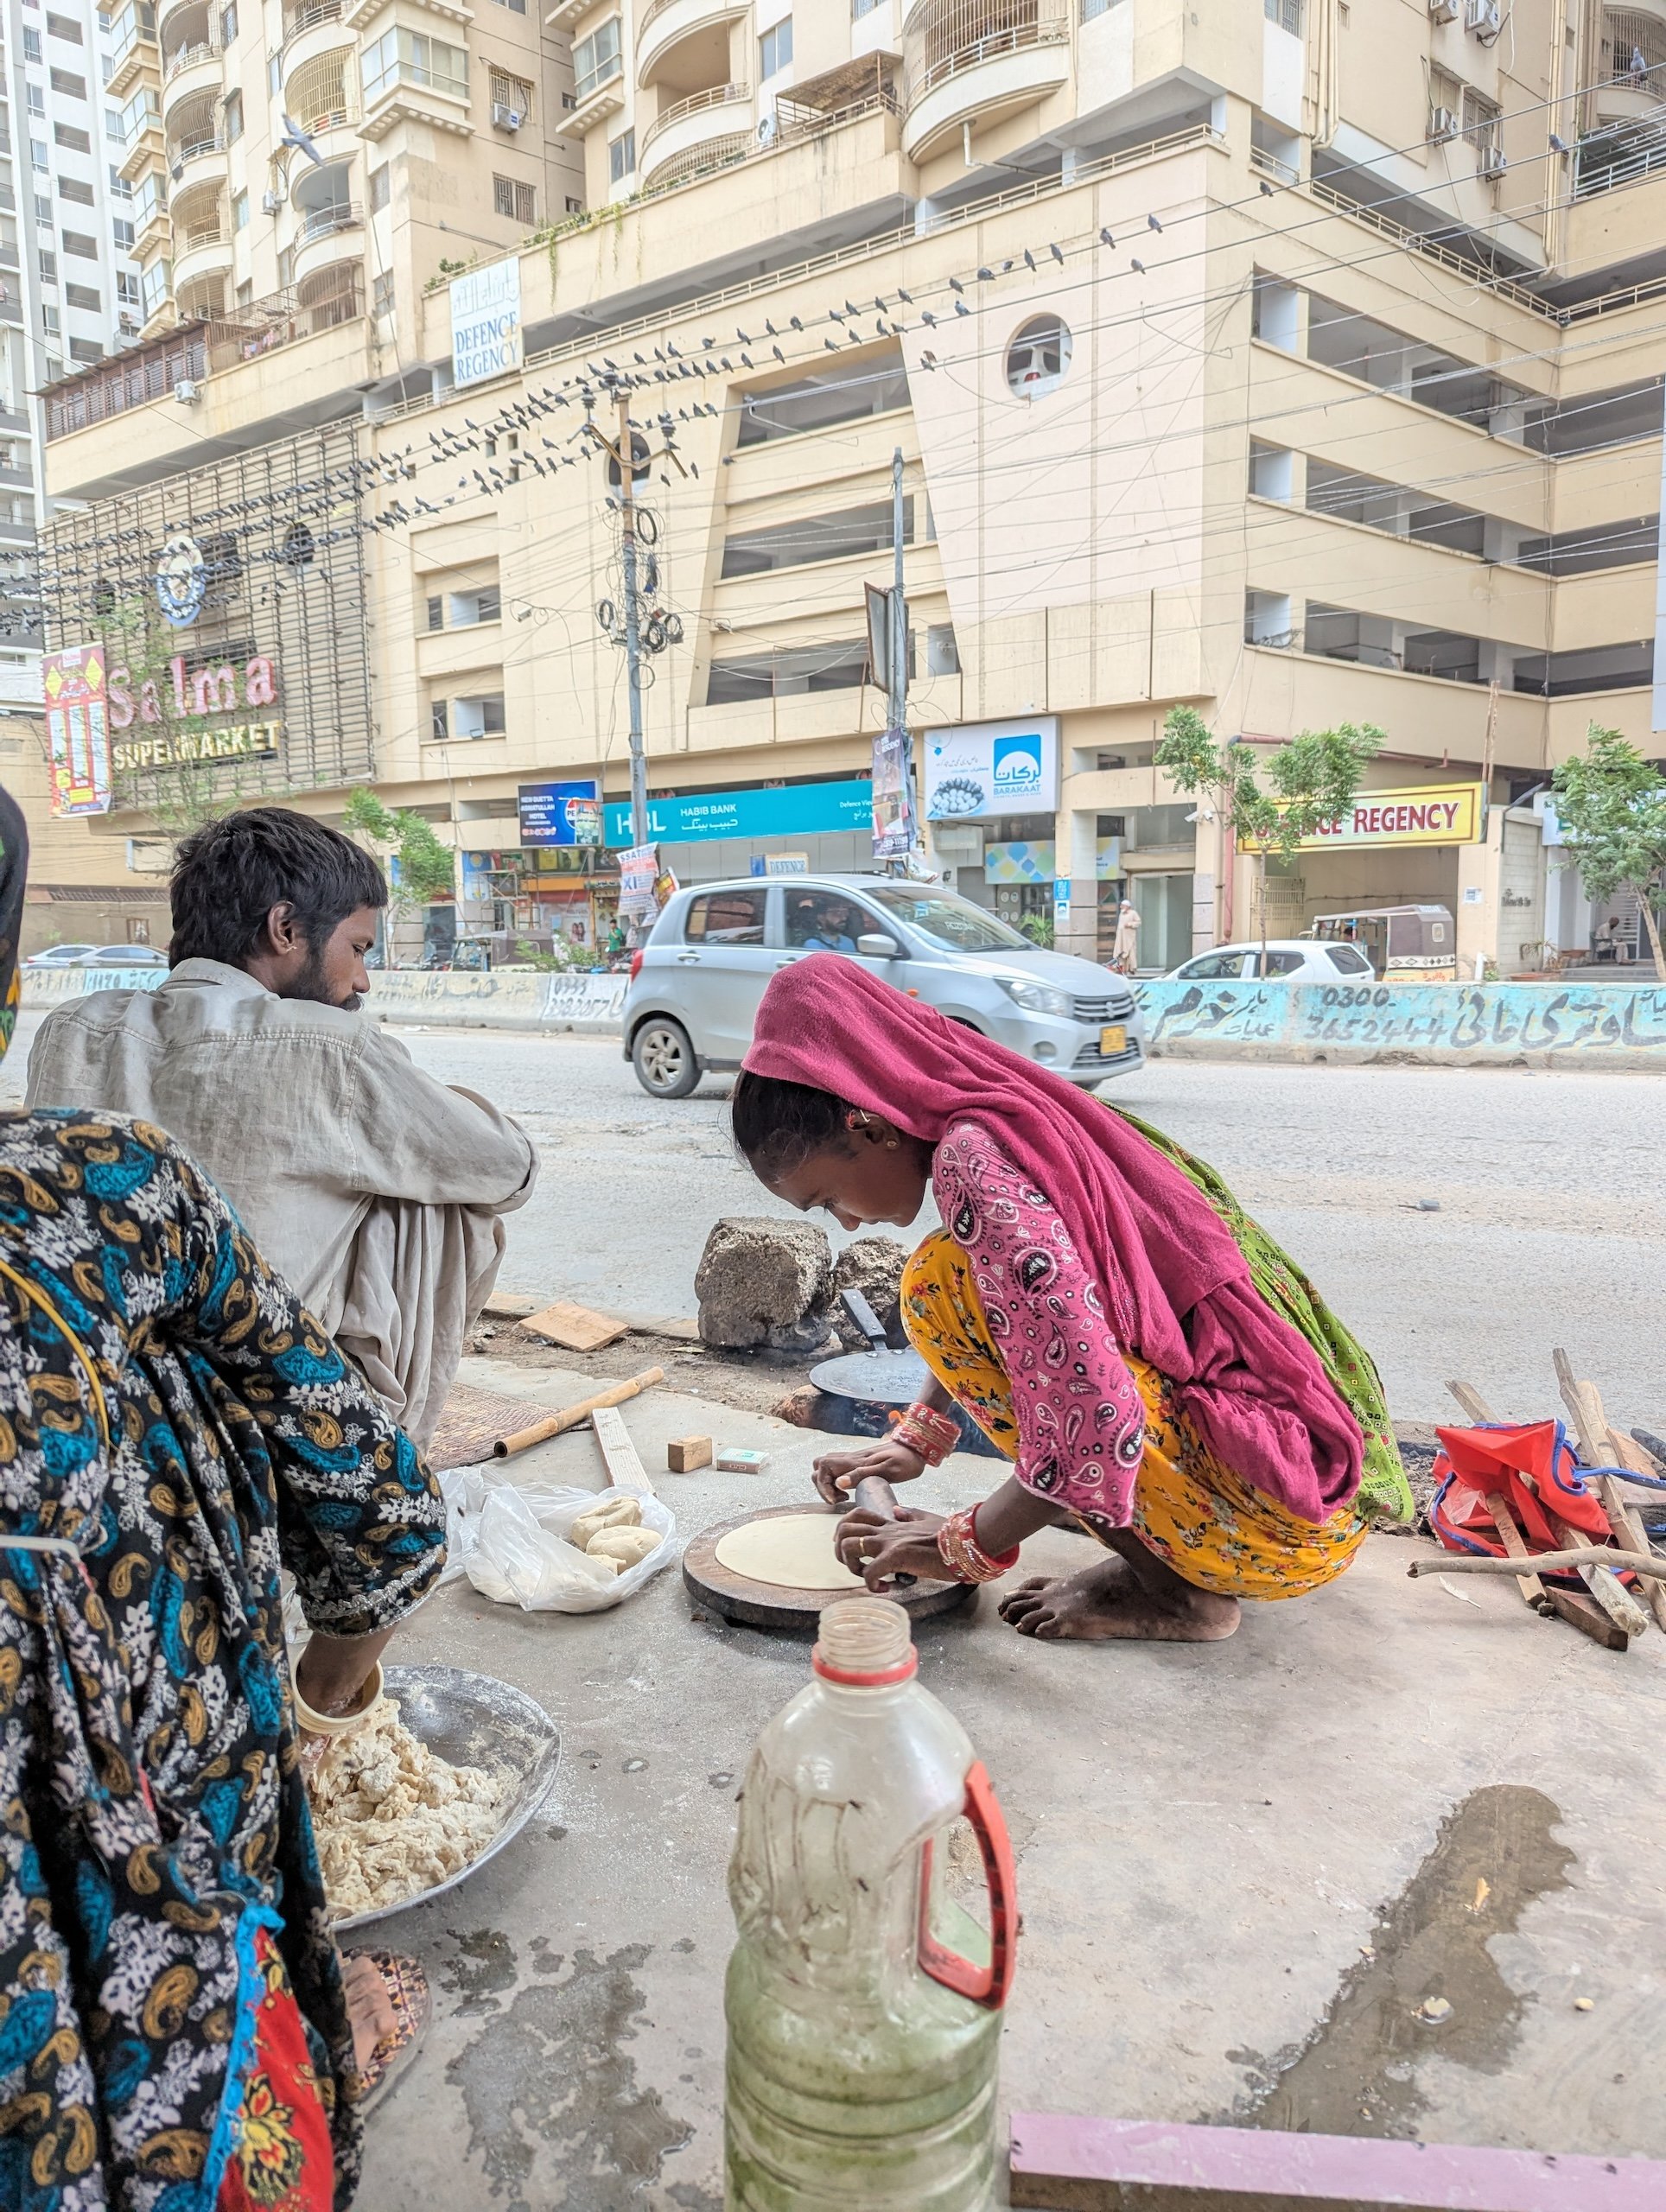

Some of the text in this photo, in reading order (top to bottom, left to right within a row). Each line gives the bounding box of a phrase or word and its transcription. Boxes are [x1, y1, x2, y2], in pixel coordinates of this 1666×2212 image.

[455, 311, 518, 354] DEFENCE
[456, 339, 518, 381] REGENCY
[108, 655, 277, 728] Salma
[994, 784, 1040, 795] BARAKAAT
[616, 810, 667, 835] HL
[680, 804, 737, 817] HABIB BANK
[1353, 802, 1459, 834] REGENCY
[769, 860, 805, 874] DEFENCE
[624, 876, 638, 890] XI
[1303, 1014, 1448, 1045] 3652444
